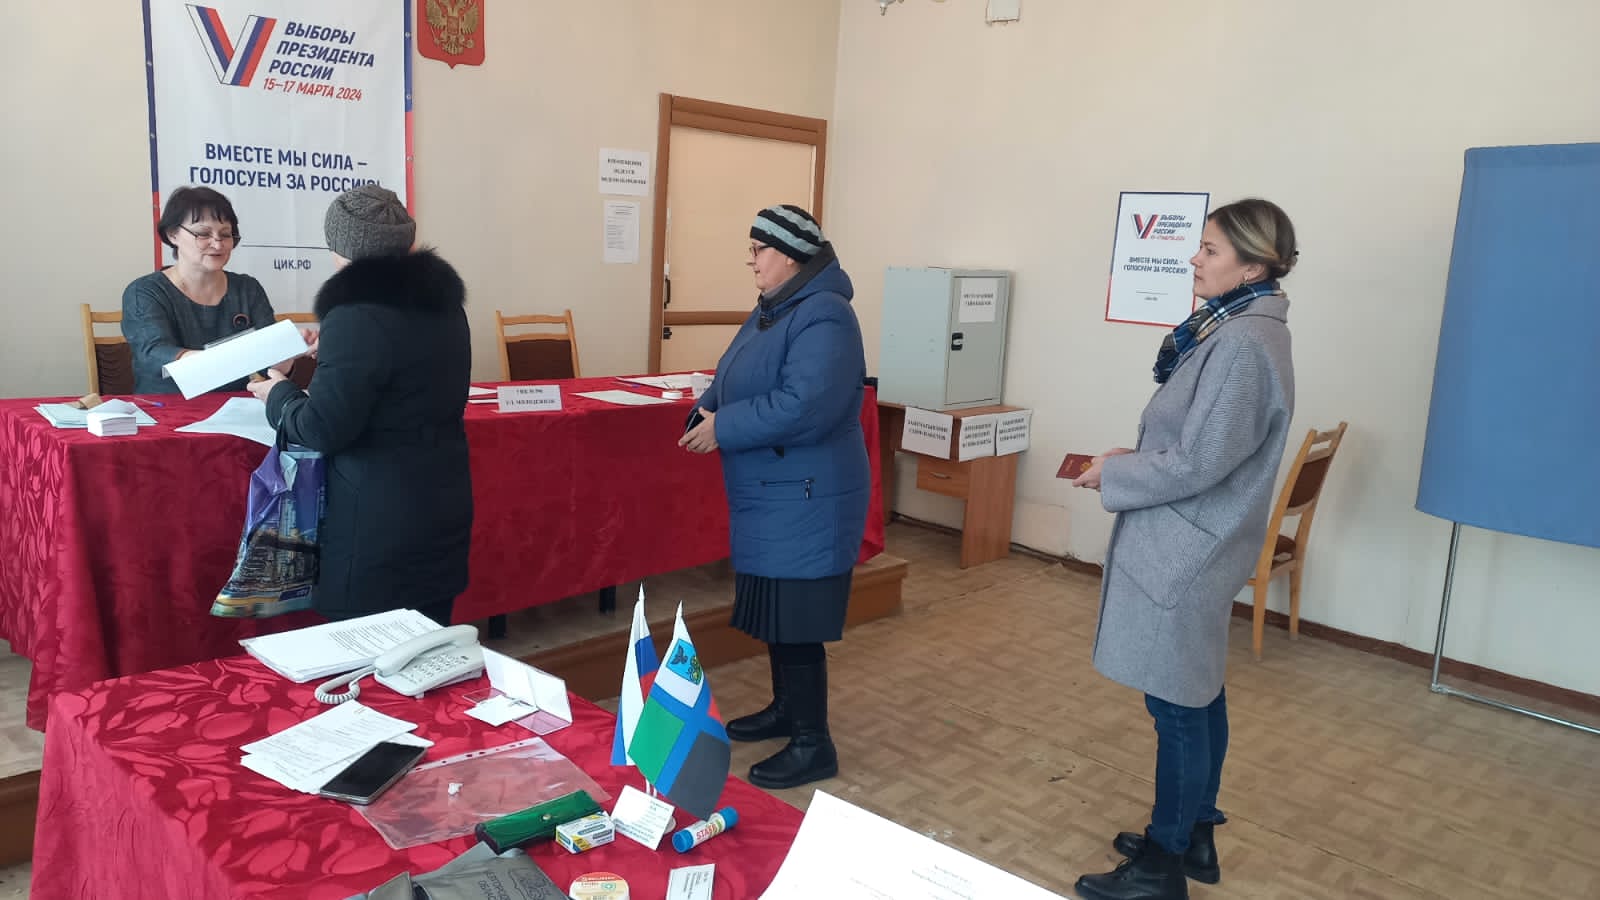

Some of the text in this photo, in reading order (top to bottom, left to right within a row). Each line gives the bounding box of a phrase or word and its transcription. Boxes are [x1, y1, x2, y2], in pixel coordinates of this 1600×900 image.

[284, 21, 356, 45] ВЫБОРЫ
[276, 40, 375, 68] ПРЕЗИДЕНТА
[268, 59, 334, 81] РОССИИ
[296, 81, 335, 97] МАРТА
[335, 87, 362, 101] 2024
[205, 143, 273, 164] ВМЕСТЕ
[278, 149, 307, 167] МЫ
[311, 152, 354, 171] СИЛА
[189, 166, 281, 188] ГОЛОСУЕМ
[286, 173, 305, 190] ЗА
[273, 259, 312, 271] ЦИК.РФ
